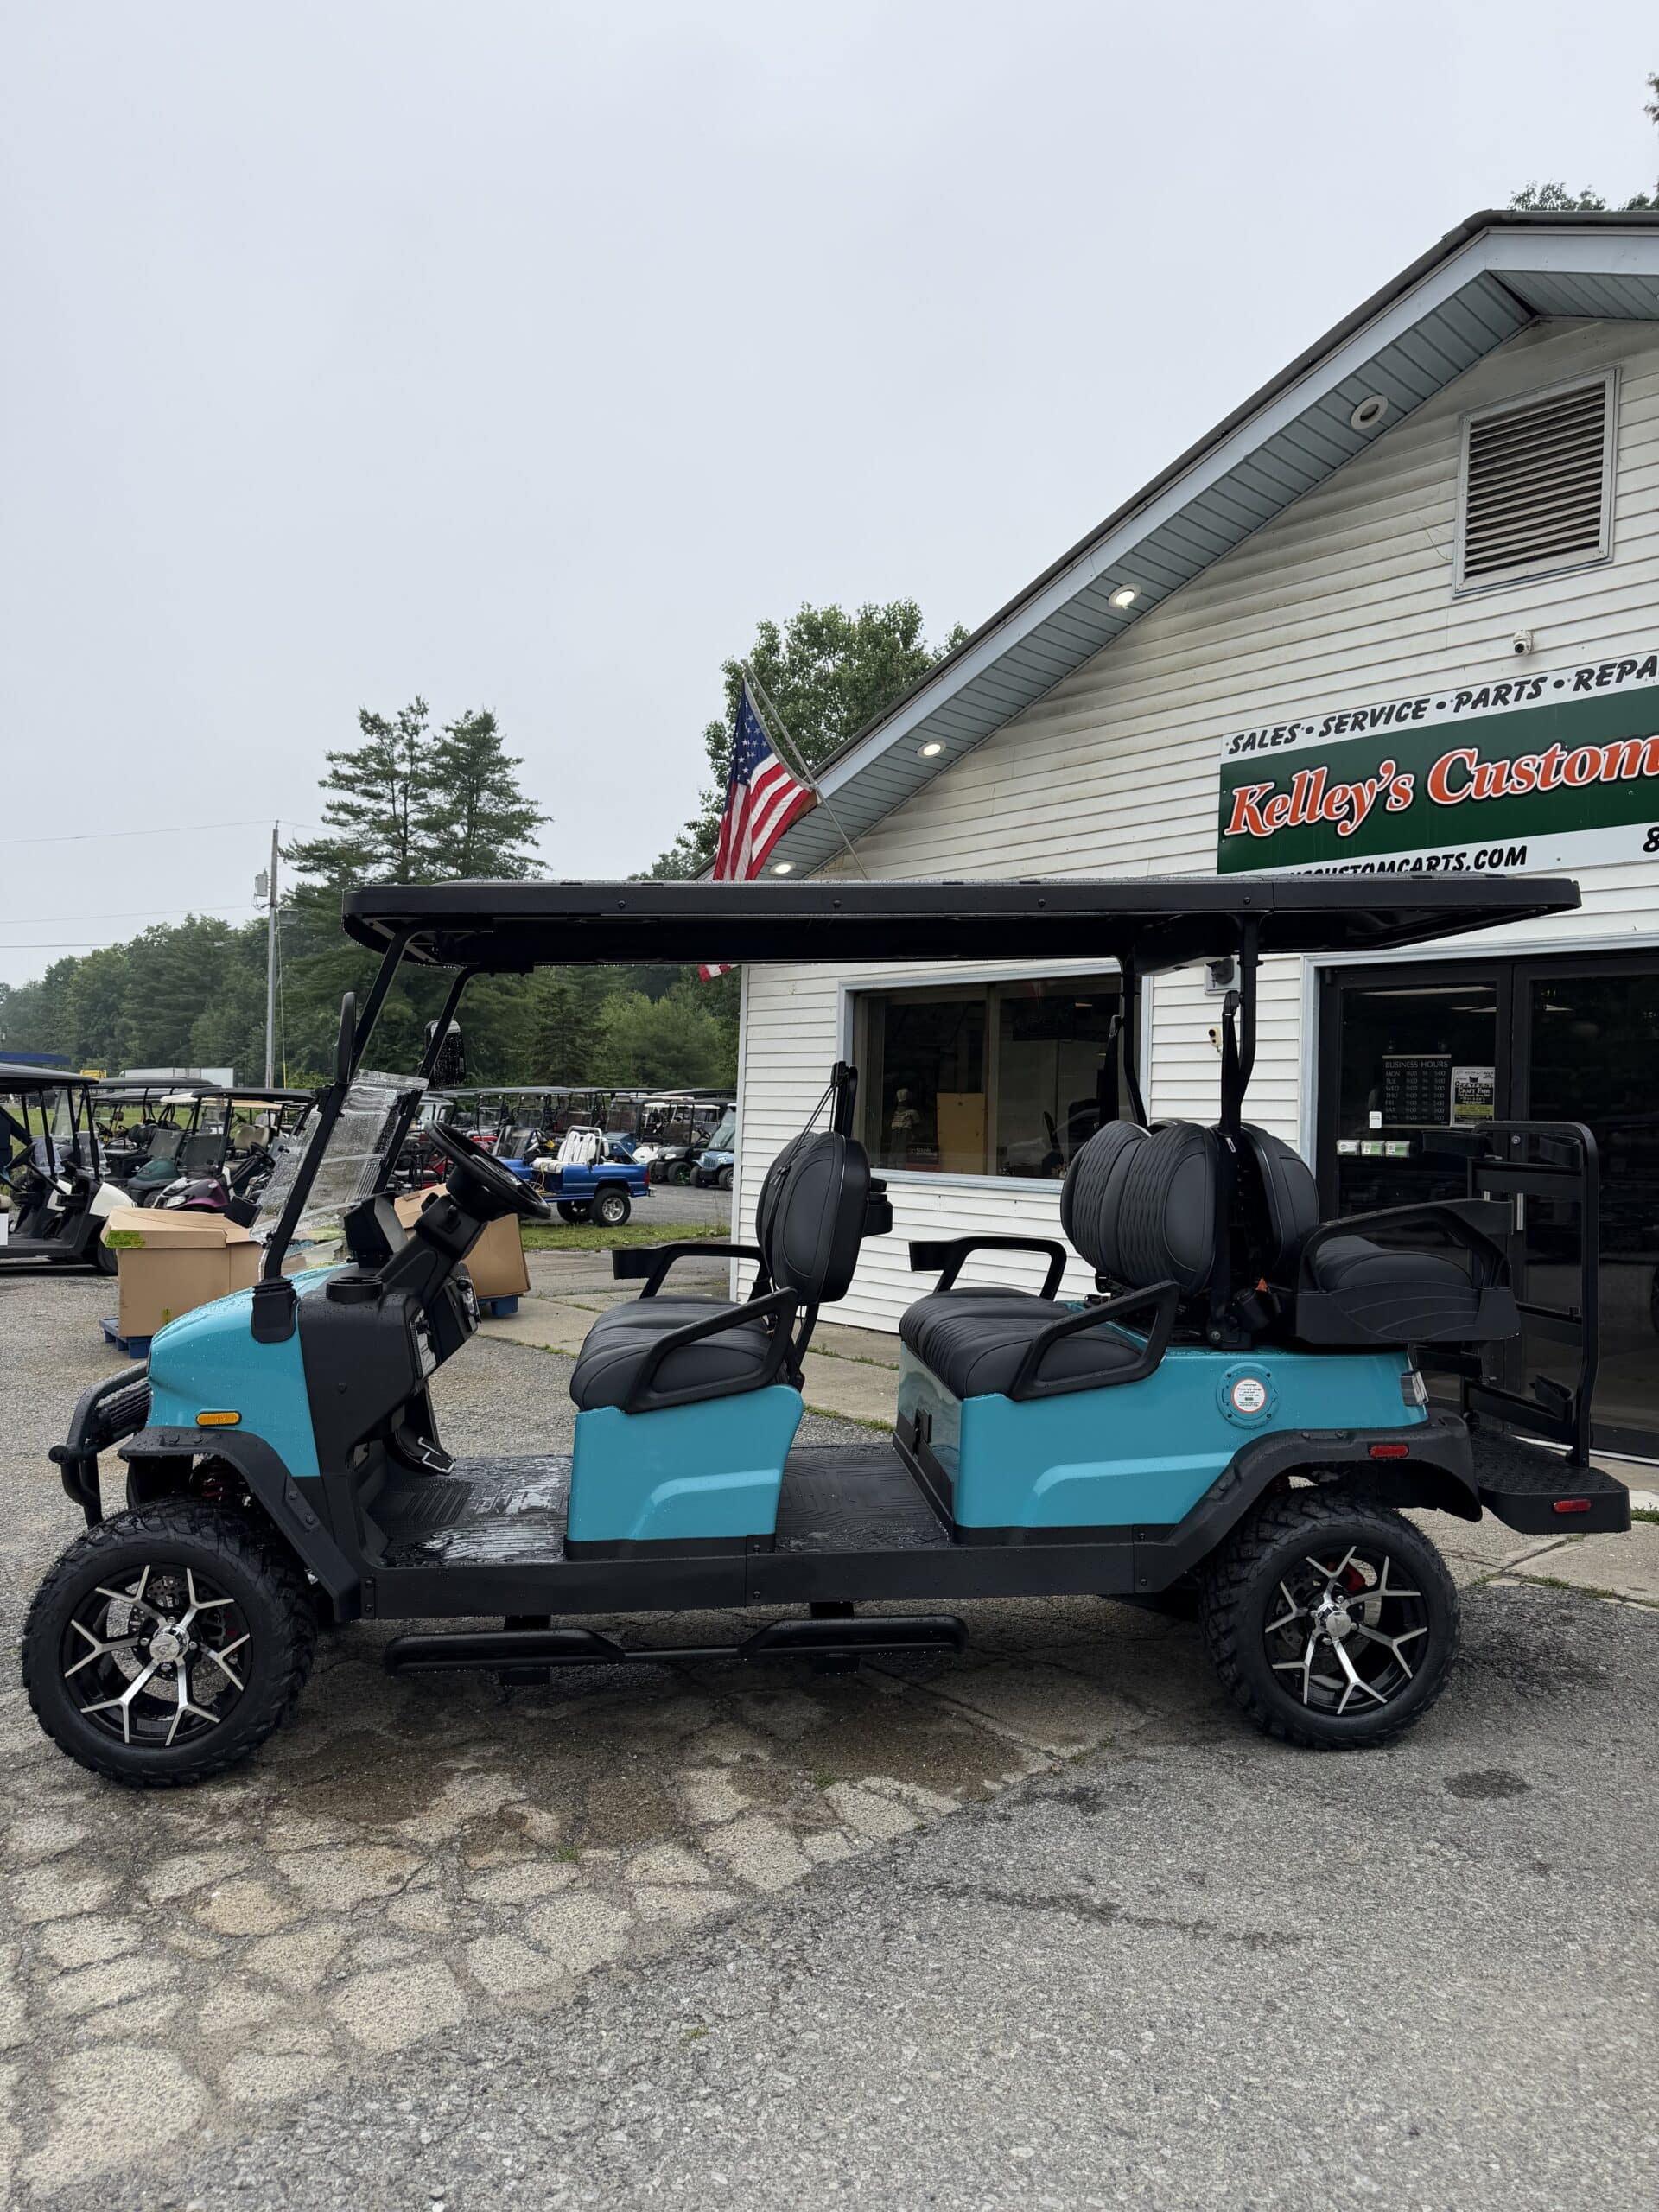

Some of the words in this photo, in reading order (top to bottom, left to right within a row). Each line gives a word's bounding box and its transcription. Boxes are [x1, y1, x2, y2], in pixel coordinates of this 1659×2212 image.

[1228, 723, 1301, 755] SALES
[1319, 698, 1431, 737] SERVICE
[1452, 676, 1548, 713] PARTS
[1224, 760, 1415, 836] Kelley's
[1427, 734, 1659, 804] Custom
